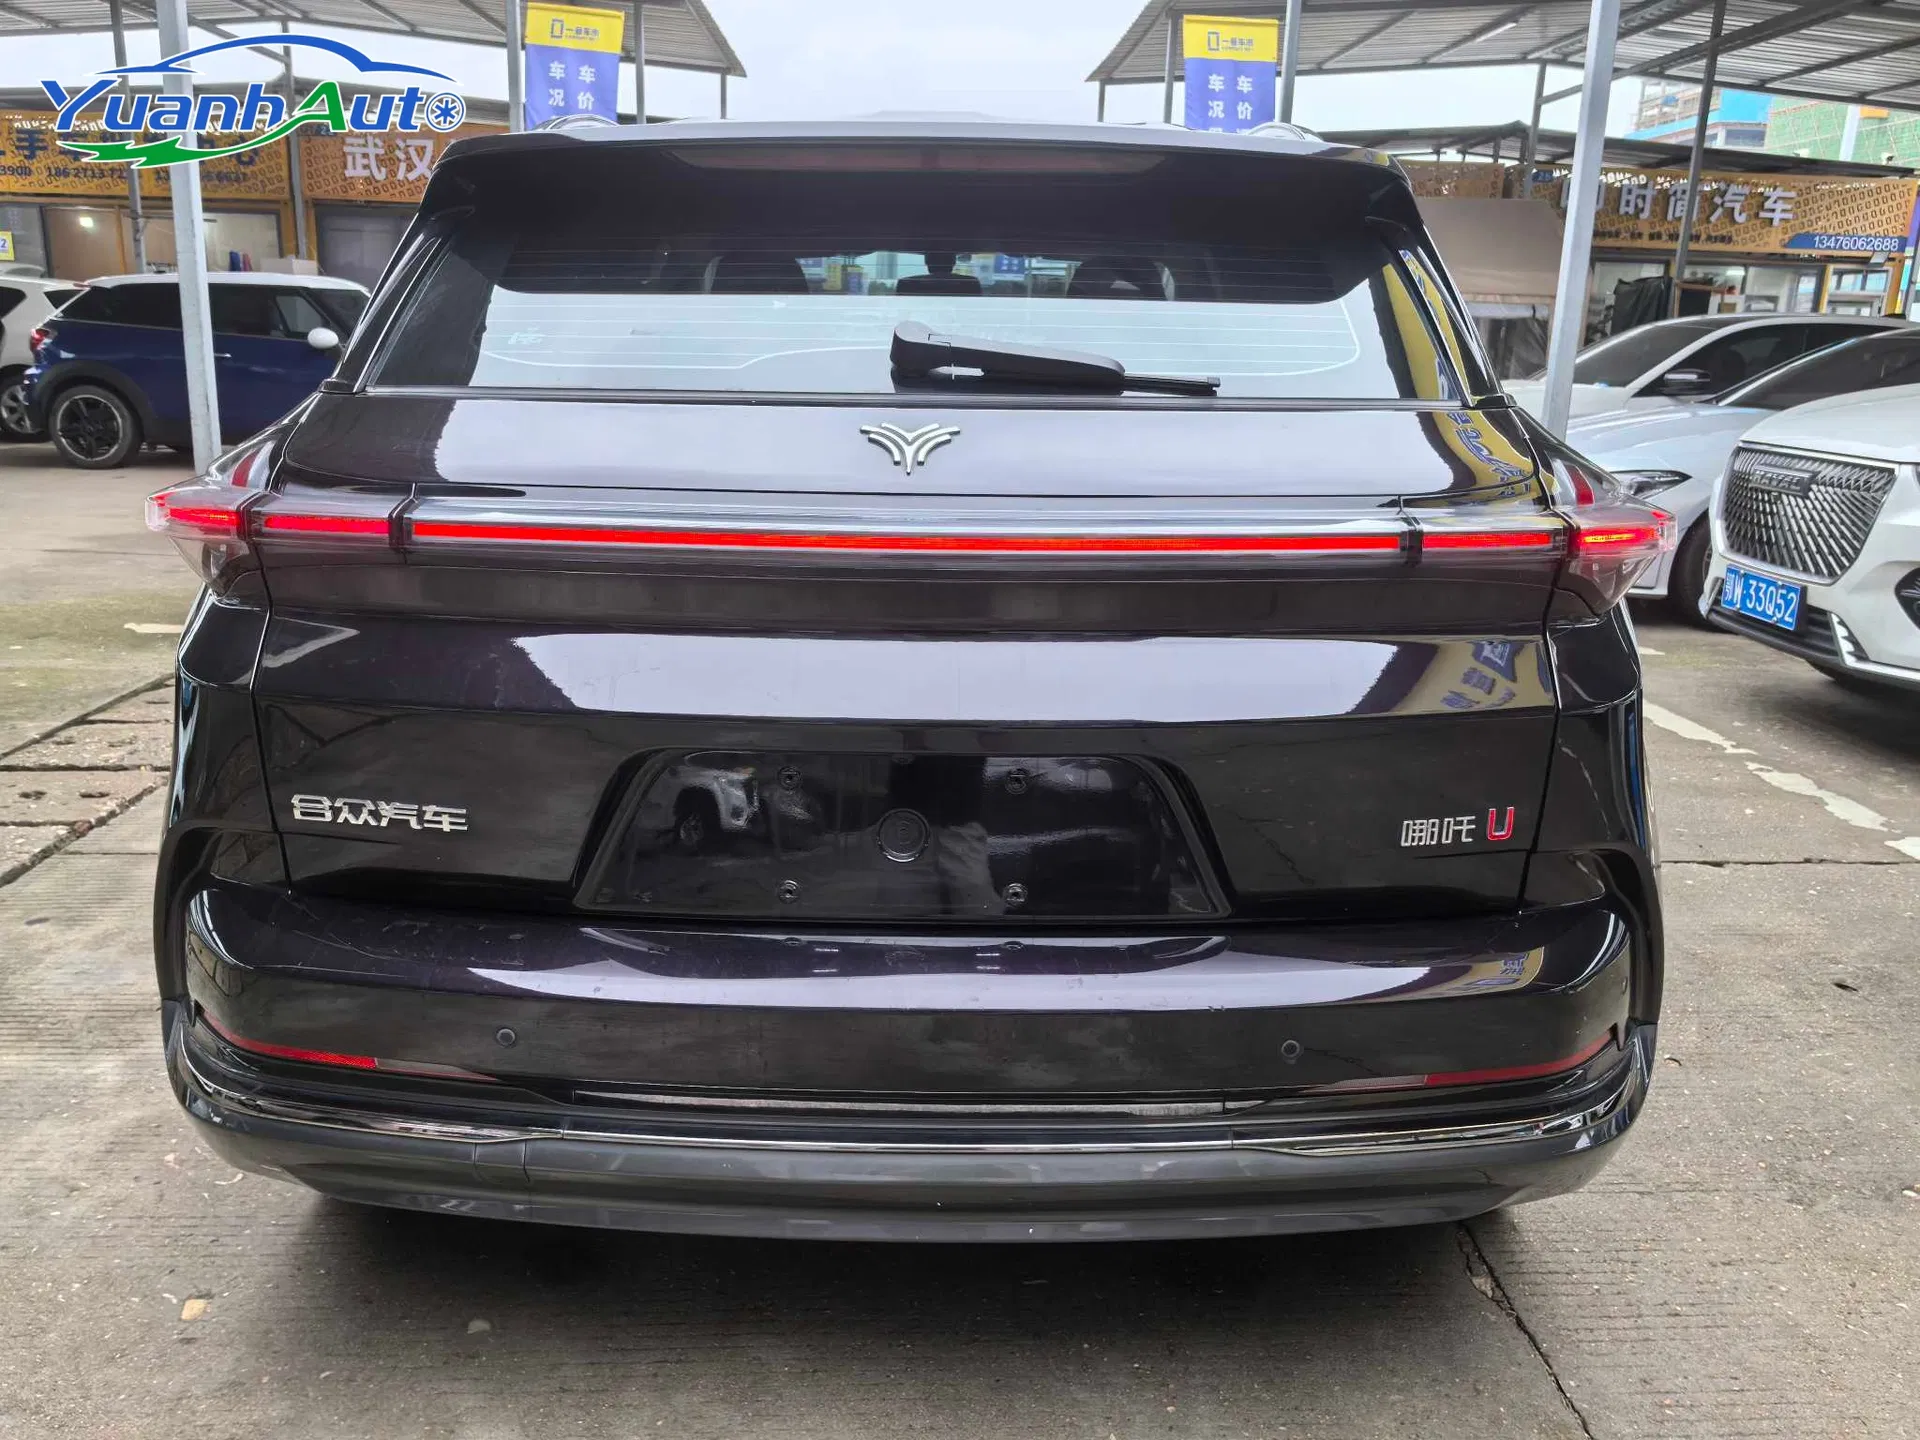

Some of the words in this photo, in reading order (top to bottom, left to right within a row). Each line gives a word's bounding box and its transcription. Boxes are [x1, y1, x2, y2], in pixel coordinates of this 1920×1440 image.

[1207, 73, 1225, 133] 车况
[1236, 75, 1253, 134] 车价
[1813, 235, 1899, 251] 13476062688
[291, 793, 469, 832] 合众汽车
[1400, 815, 1476, 847] 哪吒
[1487, 806, 1515, 841] U
